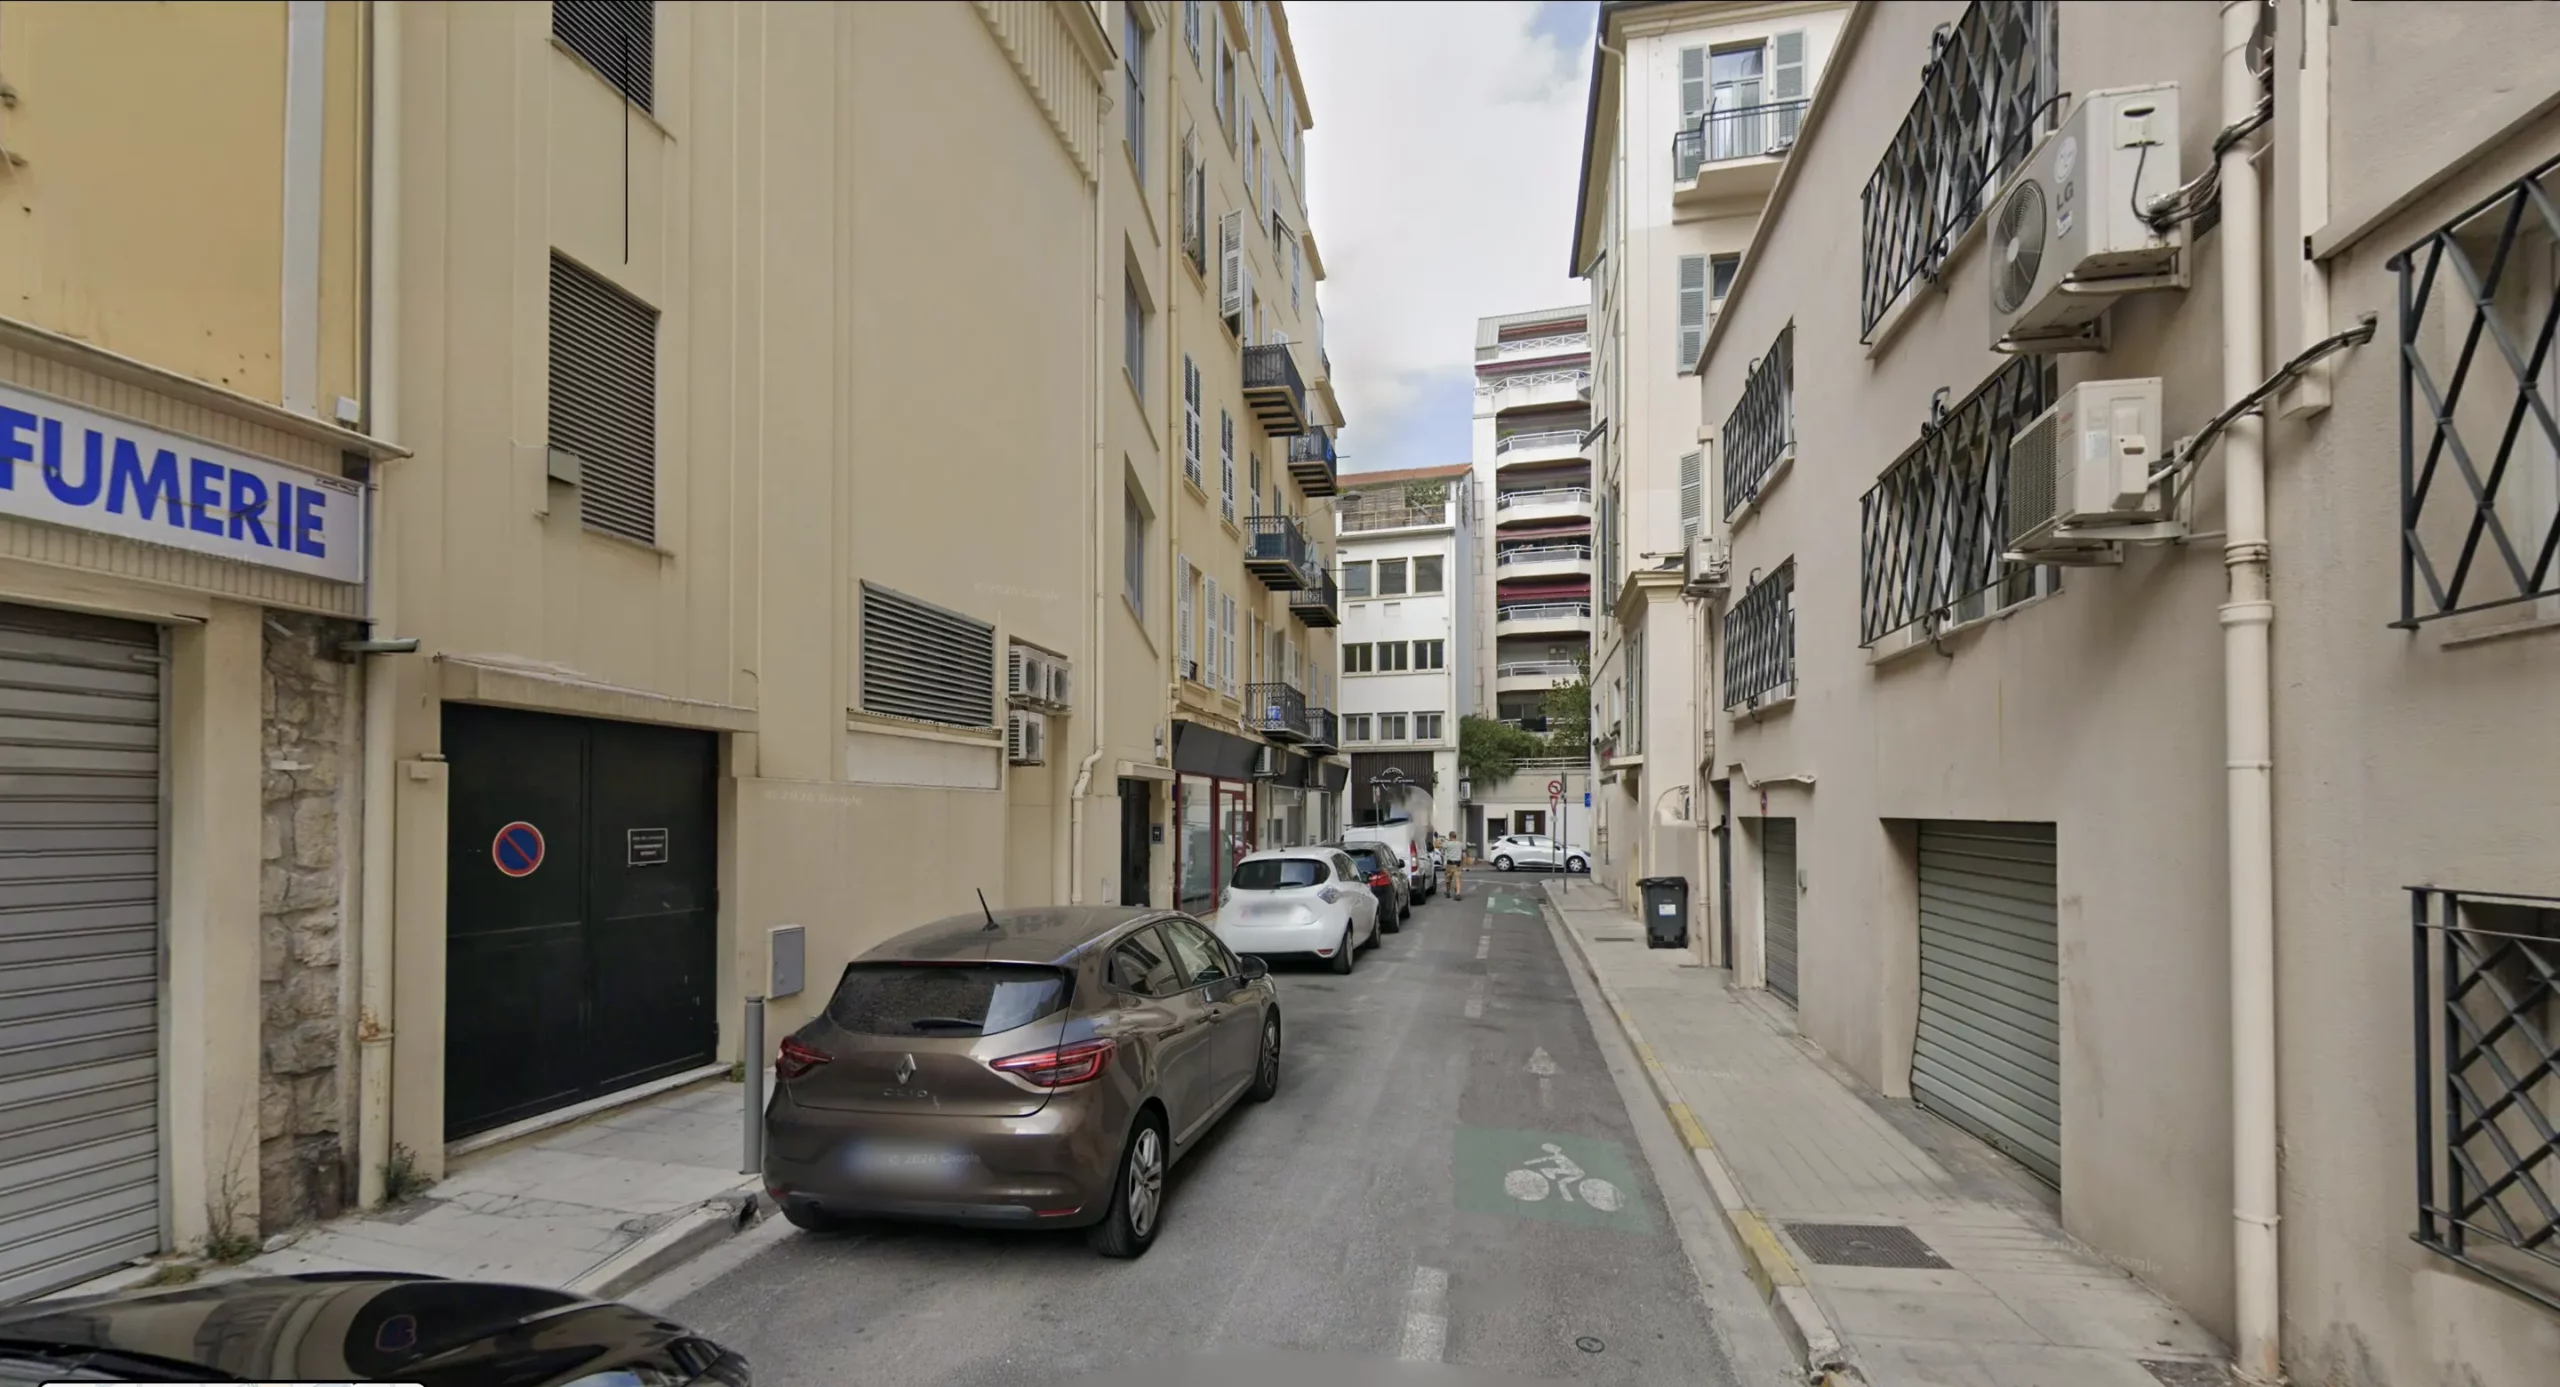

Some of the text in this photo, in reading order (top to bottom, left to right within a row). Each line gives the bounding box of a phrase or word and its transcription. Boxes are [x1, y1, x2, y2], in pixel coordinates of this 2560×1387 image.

[2056, 181, 2074, 212] LG
[0, 405, 326, 559] FUMERIE
[883, 1088, 928, 1098] CLIO
